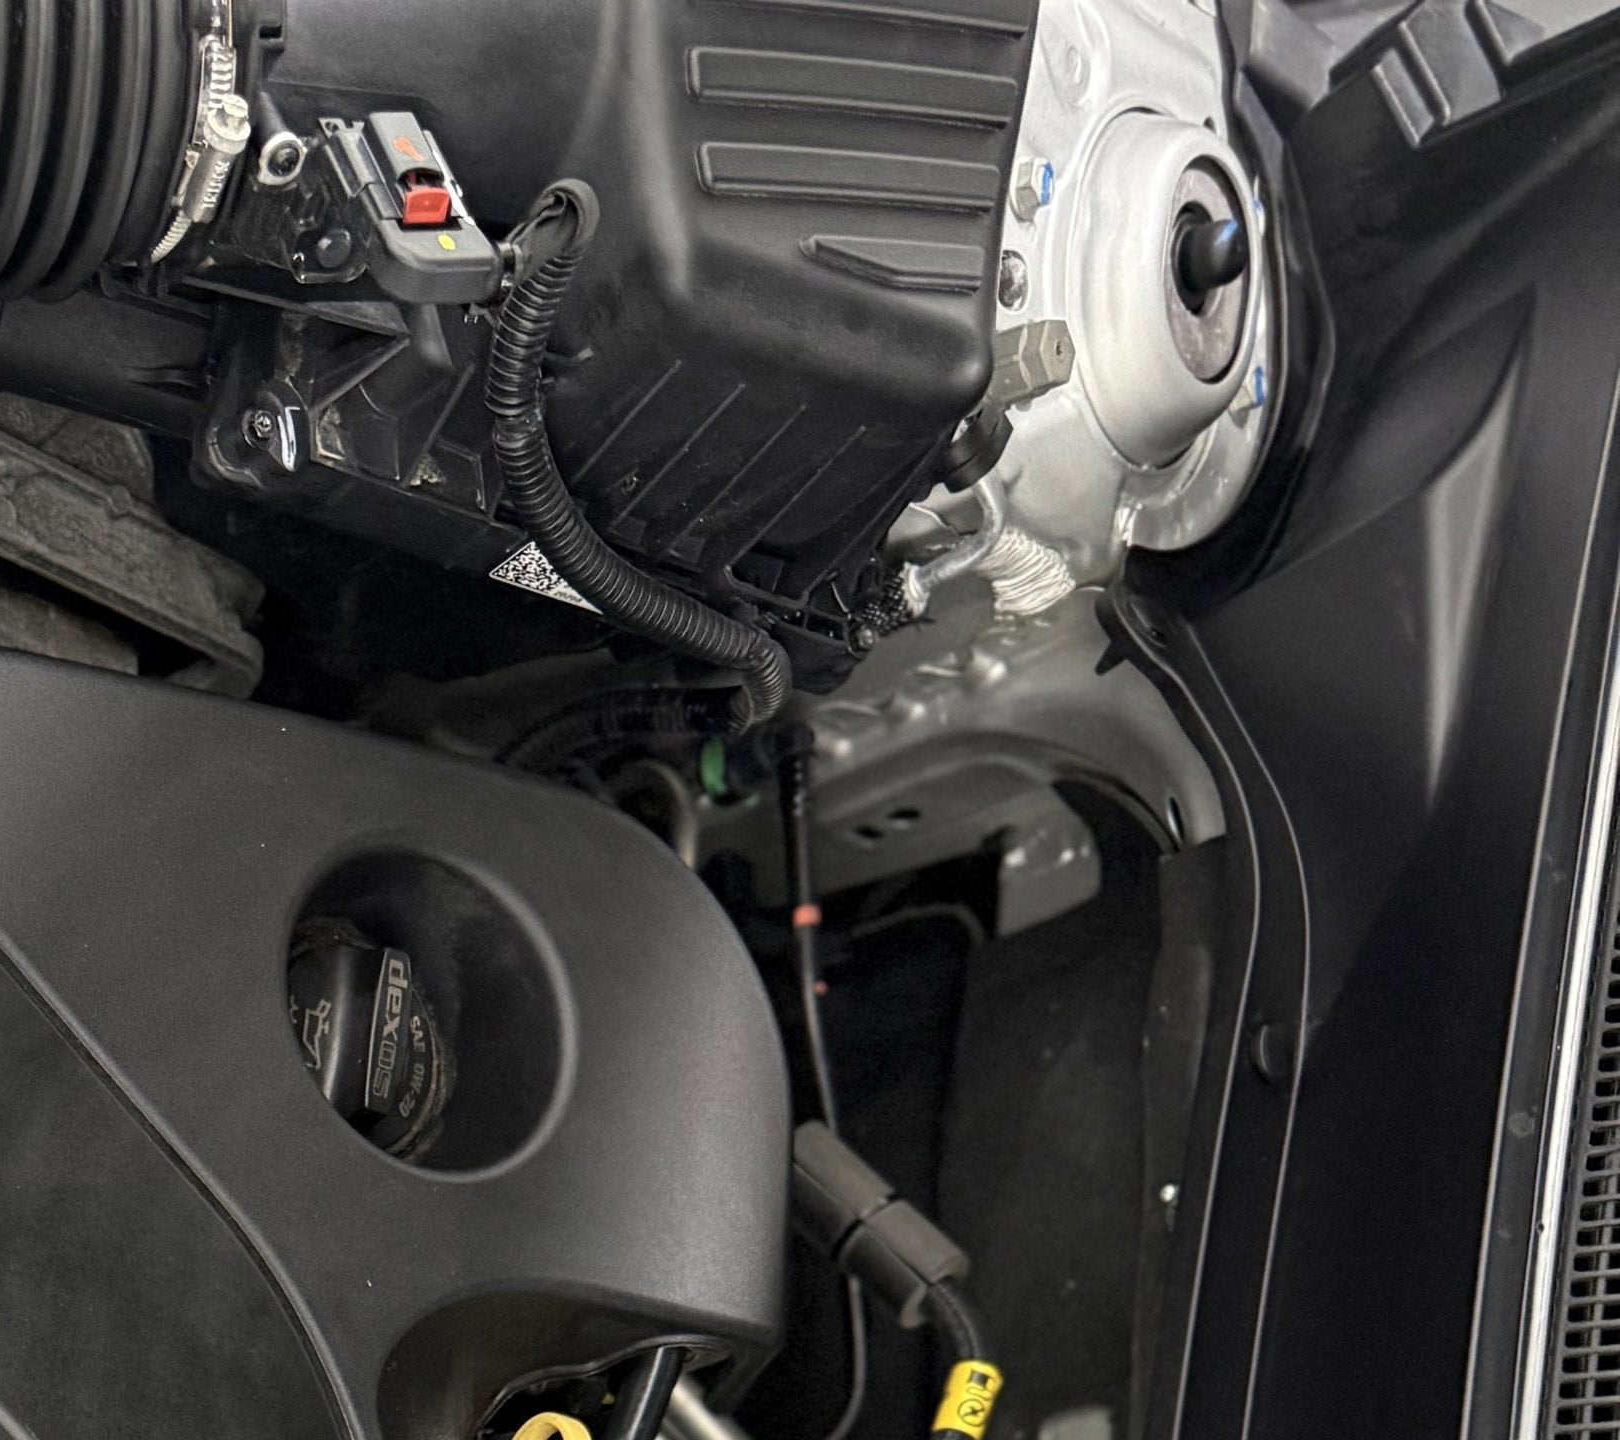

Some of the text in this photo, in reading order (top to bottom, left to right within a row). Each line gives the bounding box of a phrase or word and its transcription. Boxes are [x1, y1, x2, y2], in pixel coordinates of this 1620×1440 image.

[371, 957, 409, 1099] dexos
[397, 1015, 426, 1119] SAE 0W-20
